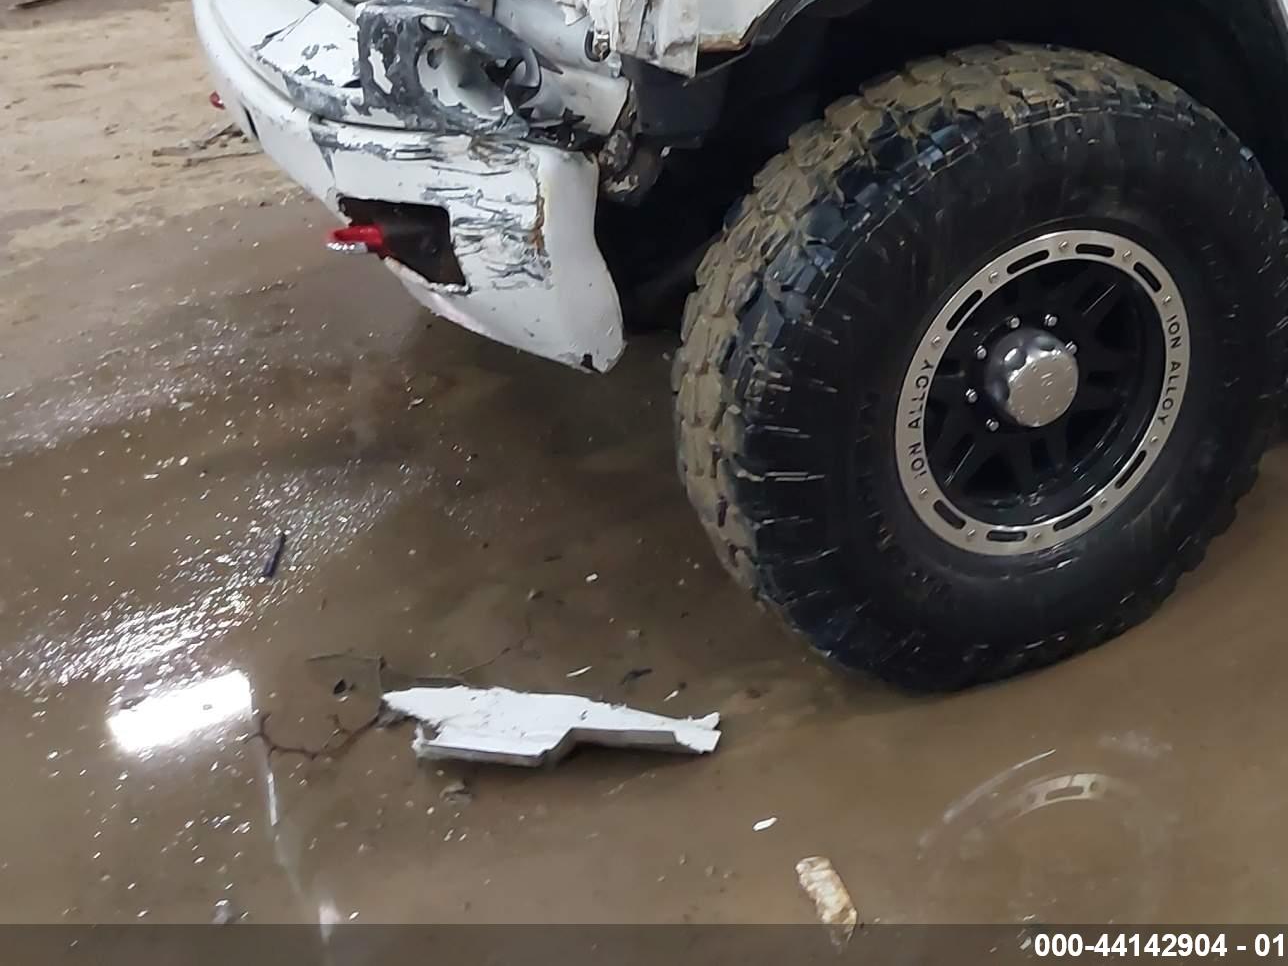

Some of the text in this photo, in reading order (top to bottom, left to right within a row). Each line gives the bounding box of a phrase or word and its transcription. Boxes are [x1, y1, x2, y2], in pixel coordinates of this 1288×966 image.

[908, 359, 934, 480] ION ALLOY
[1158, 315, 1181, 425] ION ALLOY
